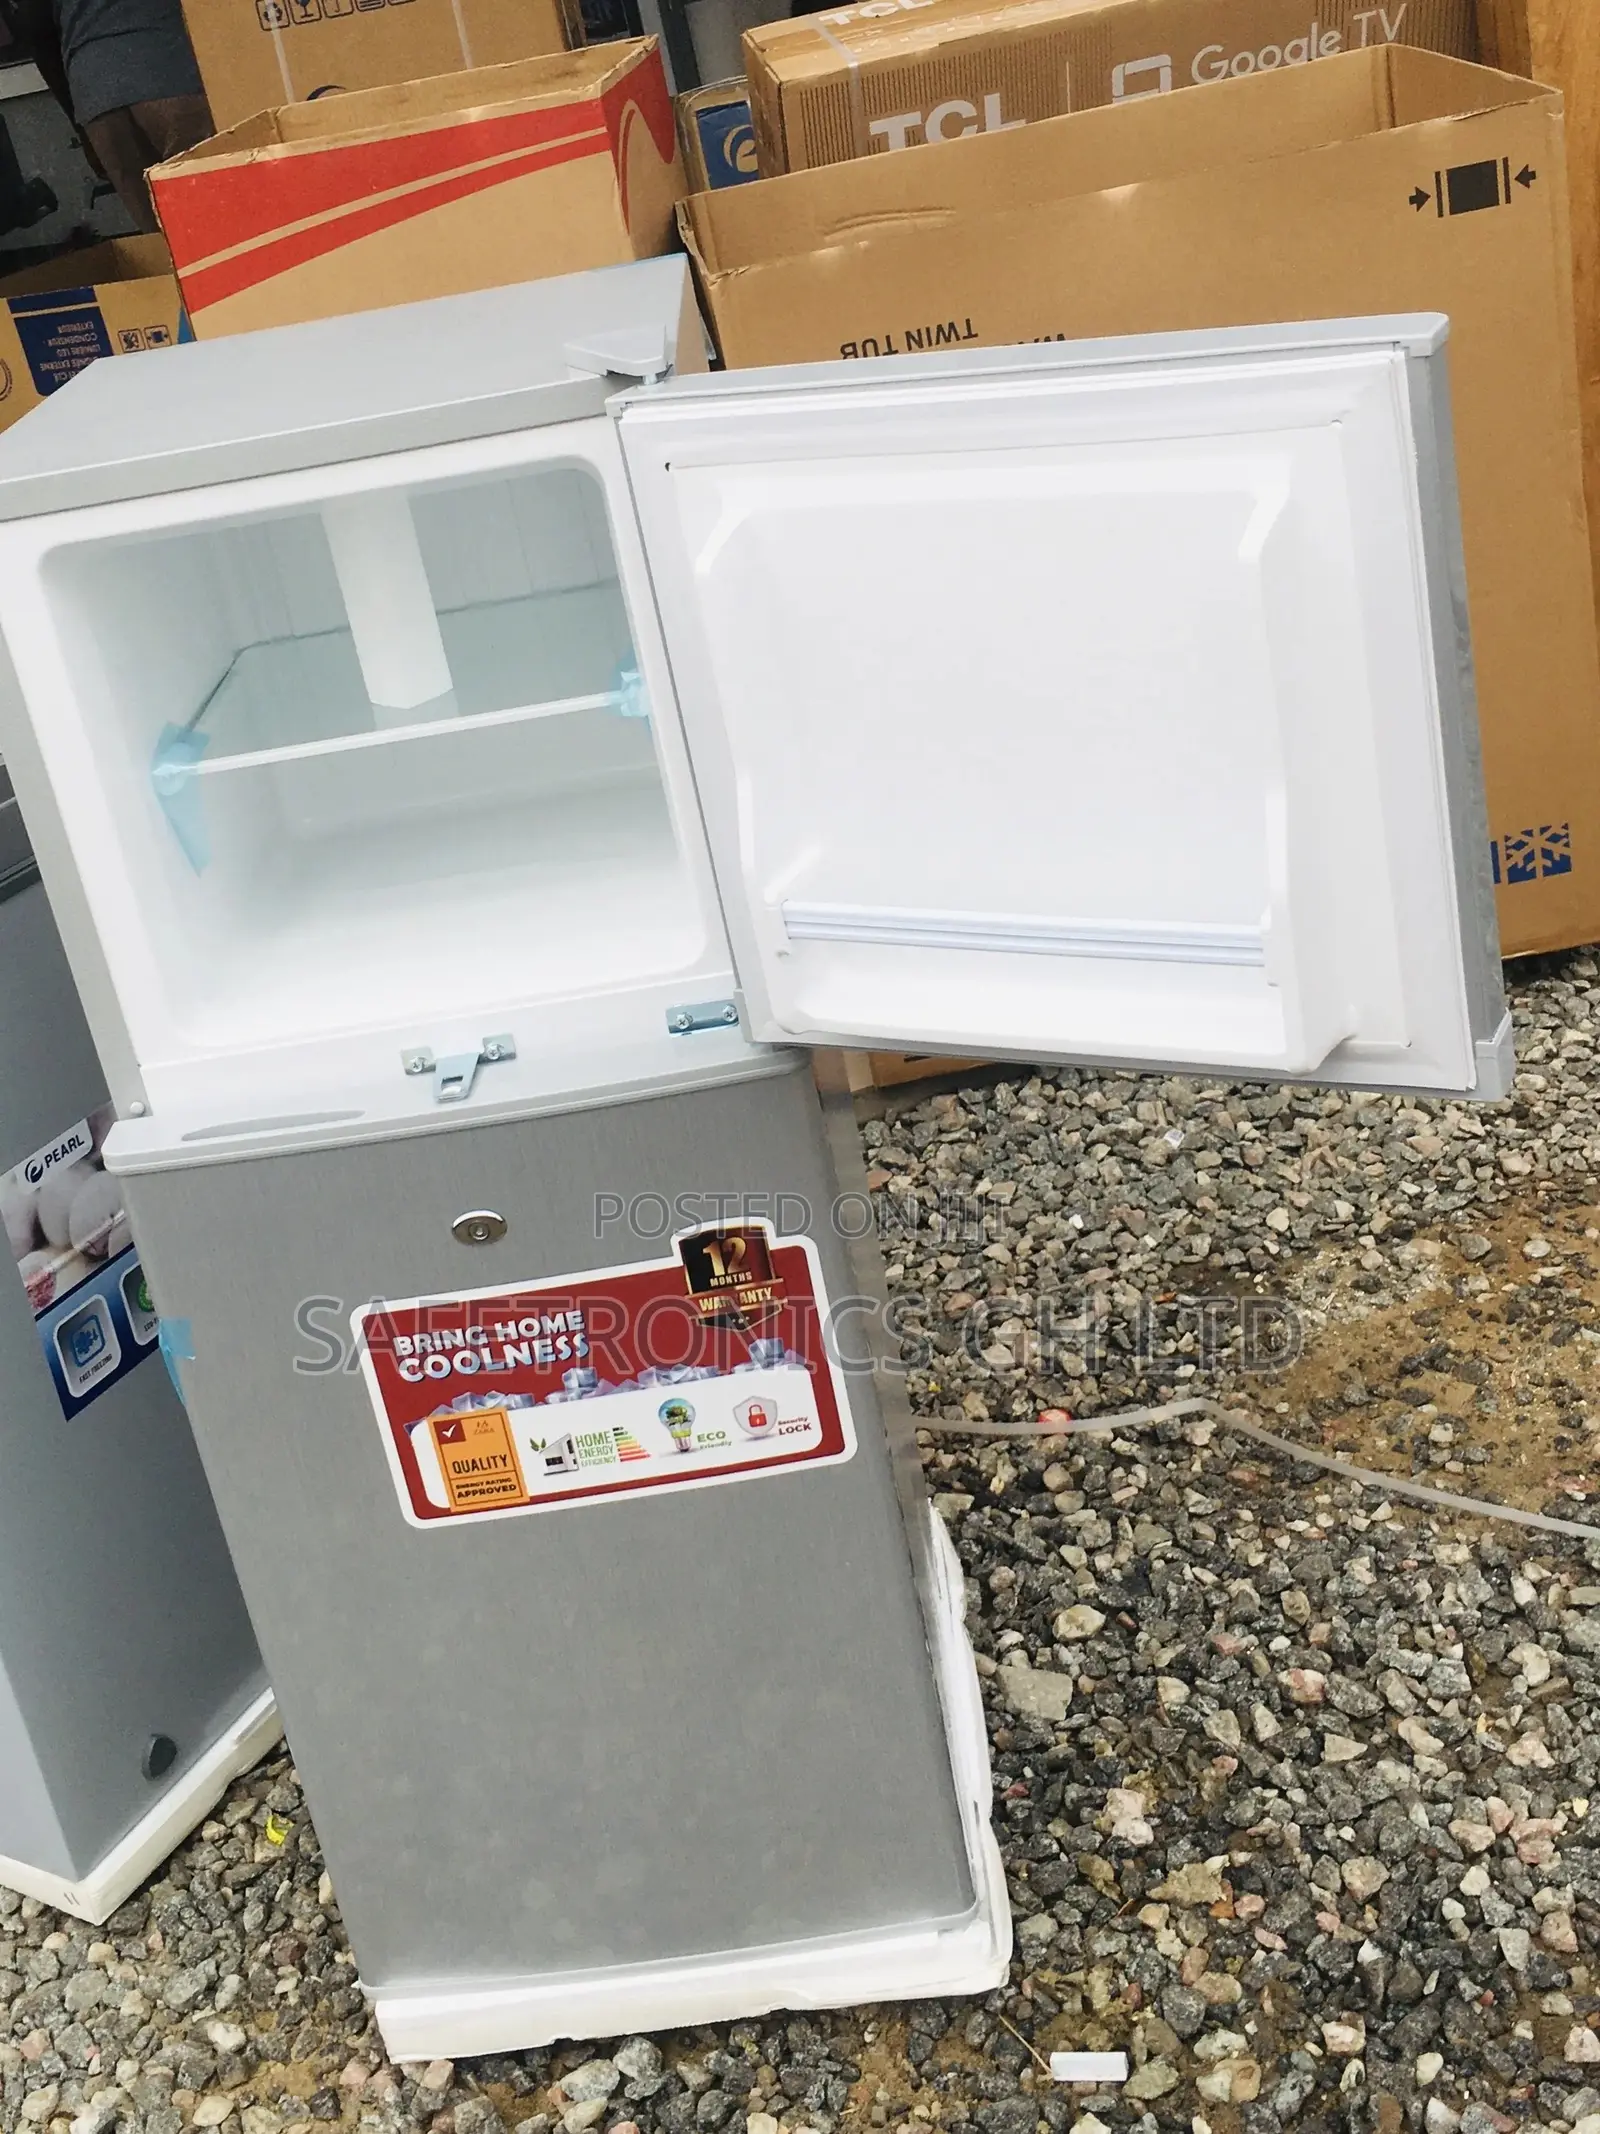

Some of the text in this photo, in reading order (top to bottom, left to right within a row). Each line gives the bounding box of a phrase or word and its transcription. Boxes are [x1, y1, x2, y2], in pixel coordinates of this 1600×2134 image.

[818, 0, 936, 26] TCL
[1191, 3, 1406, 84] Google TV
[869, 93, 1026, 151] TCL
[840, 318, 978, 360] TWIN TUB
[44, 1134, 85, 1168] PEARL
[703, 1237, 748, 1276] 12
[709, 1271, 753, 1287] MONTHS
[699, 1287, 772, 1312] WARANTY
[393, 1310, 585, 1357] BRING HOME
[398, 1332, 590, 1383] COOLNESS
[575, 1431, 613, 1448] HOME
[697, 1430, 726, 1443] ECO
[779, 1423, 812, 1436] LOCK
[452, 1454, 507, 1474] QUALITY
[579, 1444, 614, 1459] ENERGY
[457, 1484, 517, 1499] APPROVED
